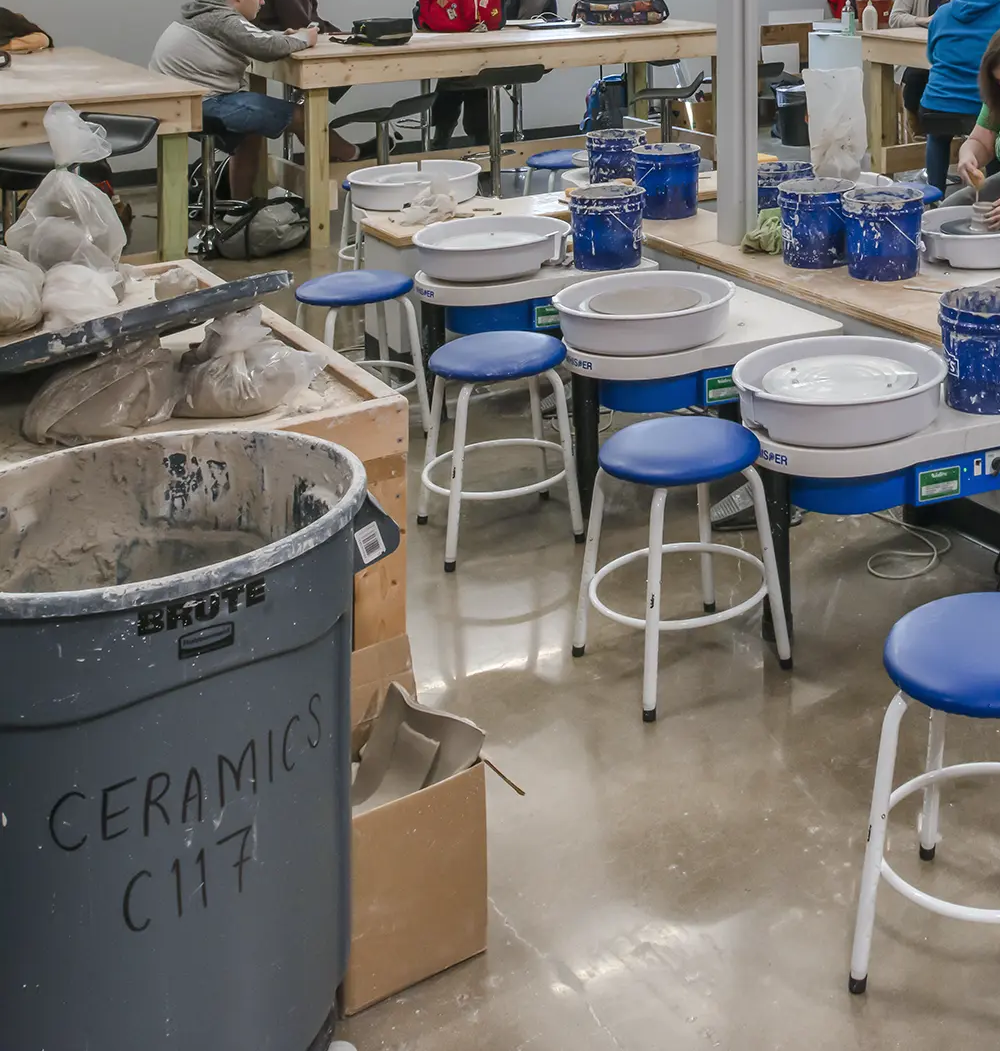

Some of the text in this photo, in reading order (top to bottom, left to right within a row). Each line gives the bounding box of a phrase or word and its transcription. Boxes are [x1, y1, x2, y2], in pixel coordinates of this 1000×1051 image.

[137, 577, 266, 637] BRUTE
[48, 693, 322, 852] CERAMICS
[122, 825, 253, 932] C117
